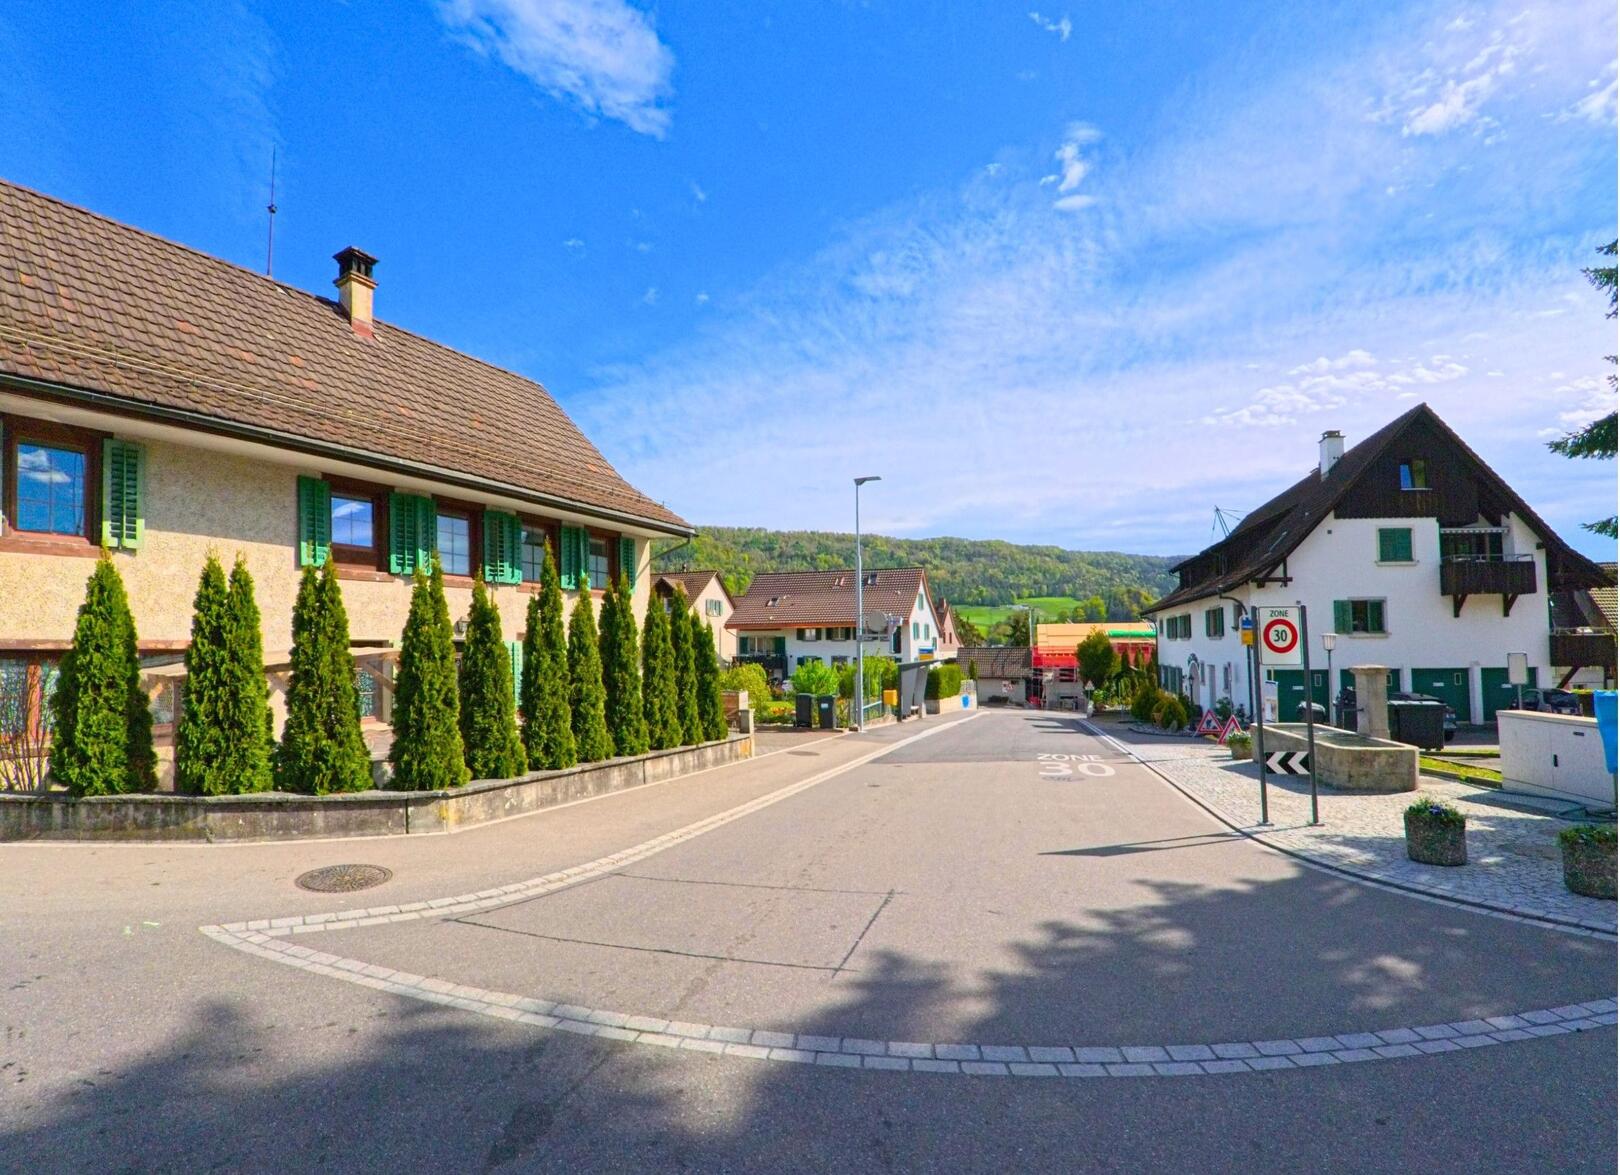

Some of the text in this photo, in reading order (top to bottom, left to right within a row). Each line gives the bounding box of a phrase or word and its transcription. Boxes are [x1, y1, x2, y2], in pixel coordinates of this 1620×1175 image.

[1274, 630, 1287, 642] 30
[1038, 753, 1104, 761] ZONE
[1039, 762, 1115, 776] 30
